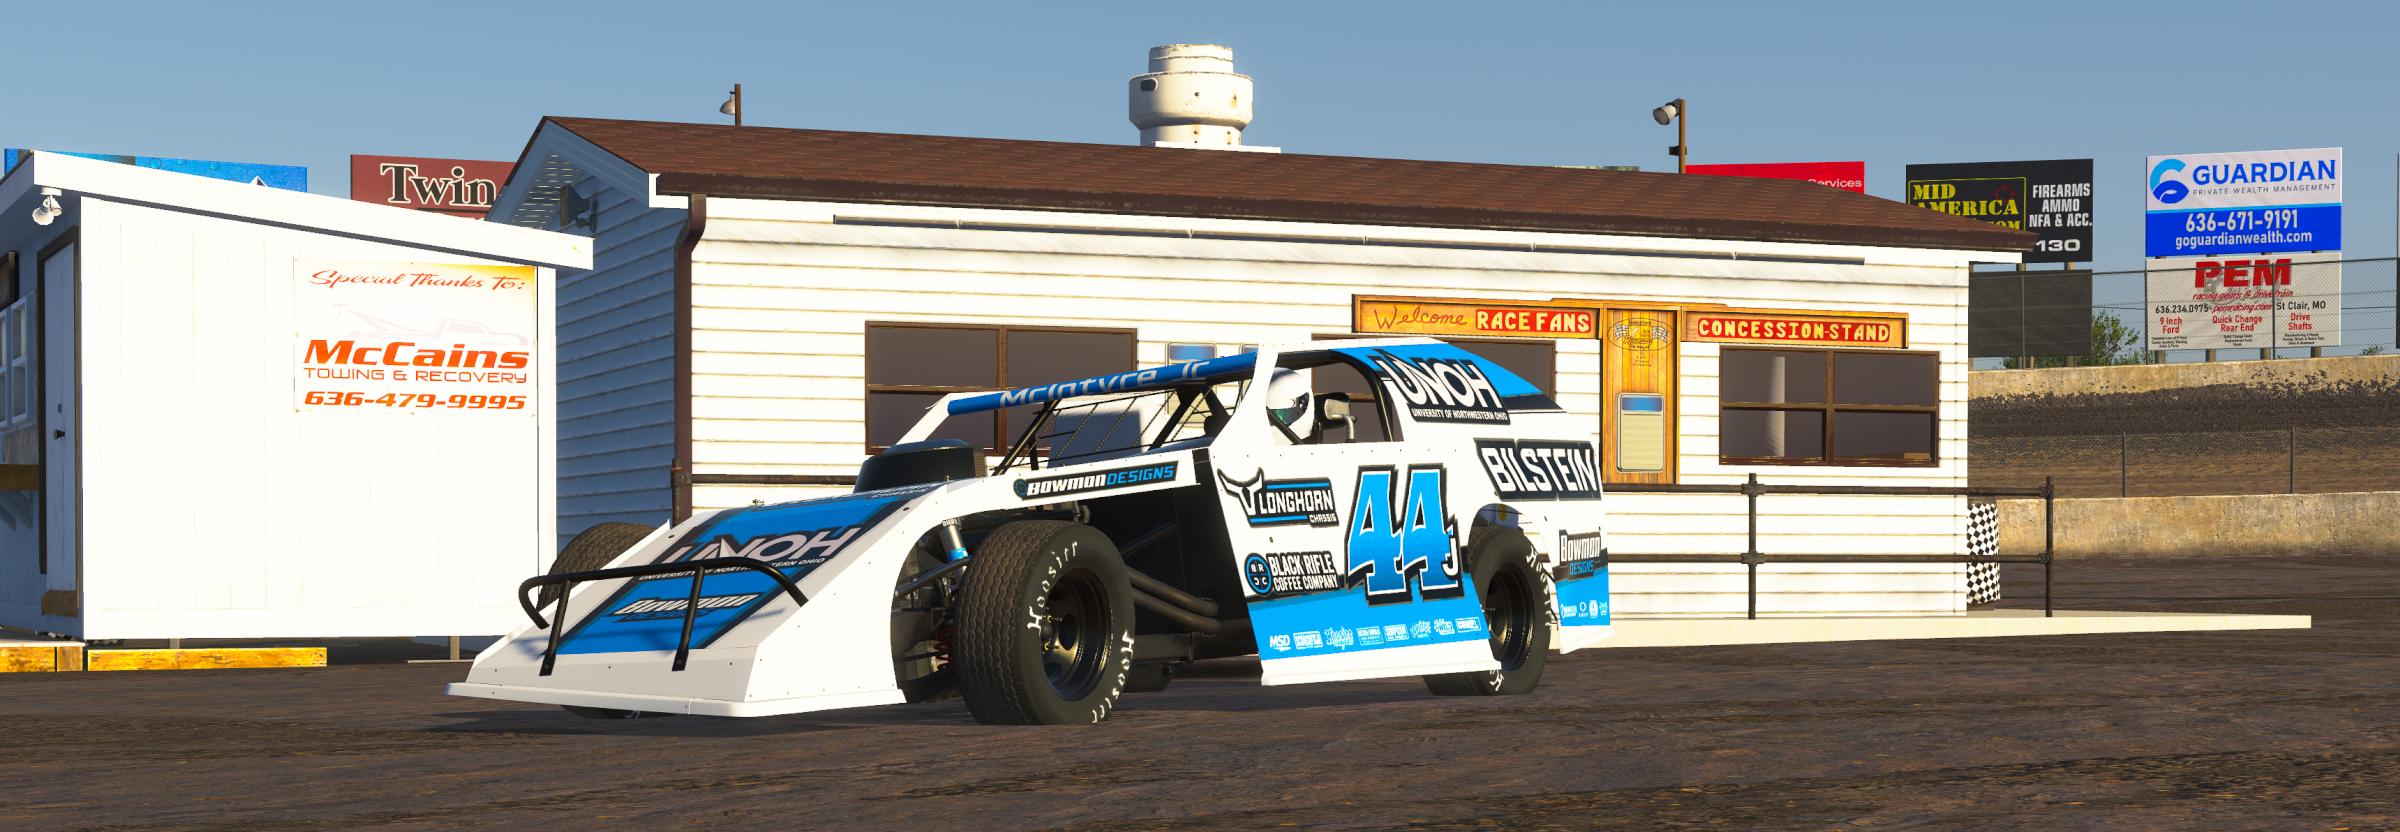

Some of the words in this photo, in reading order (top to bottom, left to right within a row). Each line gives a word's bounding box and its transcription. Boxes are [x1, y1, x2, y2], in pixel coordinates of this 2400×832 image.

[2192, 159, 2336, 186] GUARDIAN
[379, 162, 497, 208] Twin
[1912, 183, 1957, 200] MID
[2032, 183, 2091, 199] FIREARMS
[2192, 187, 2229, 196] PRIVATE
[2233, 186, 2269, 195] WEALTH
[2272, 183, 2336, 193] MANAGEMENT
[2041, 199, 2080, 213] AMMO
[2029, 214, 2051, 228] NFA
[2054, 213, 2063, 227] &
[2066, 212, 2093, 227] ACC.
[2185, 208, 2299, 233] 636-671-9191
[2035, 238, 2081, 252] 130
[2175, 230, 2313, 250] goguardianwealth.com
[309, 269, 407, 289] Special
[409, 272, 483, 289] Thanks
[492, 275, 526, 291] To:
[2195, 258, 2293, 288] PEM
[2193, 292, 2219, 301] racing
[2220, 291, 2242, 301] gears
[2244, 289, 2252, 298] &
[2155, 303, 2209, 314] 636.234.0975
[2211, 303, 2273, 314] pemracing.com
[2276, 302, 2286, 311] St
[2287, 301, 2310, 311] Clair,
[2312, 301, 2326, 310] MO
[1373, 305, 1468, 330] Welcome
[1476, 311, 1531, 331] RACE
[1535, 312, 1591, 333] FANS
[2159, 317, 2165, 325] 9
[2165, 316, 2183, 325] Inch
[2212, 315, 2233, 325] Quick
[2233, 314, 2263, 325] Change
[2290, 313, 2311, 321] Drive
[2162, 325, 2180, 334] Ford
[2220, 323, 2238, 333] Rear
[2239, 323, 2255, 332] End
[2288, 321, 2313, 331] Shafts
[303, 339, 530, 369] McCains
[303, 367, 385, 381] TOWING
[393, 370, 408, 381] &
[415, 370, 528, 384] RECOVERY
[1375, 358, 1503, 409] UNOH
[304, 390, 528, 410] 636-479-9995
[1411, 408, 1445, 419] UNIVERSITY
[1445, 410, 1453, 419] OF
[1452, 409, 1495, 420] NORTHWESTERN
[1494, 411, 1508, 421] OHIO
[1480, 447, 1599, 493] BILSTEIN
[1258, 488, 1334, 515] LONGHORN
[1308, 512, 1337, 524] CHASSIS
[1267, 554, 1305, 577] BLACK
[1302, 553, 1335, 575] RIFLE
[1568, 559, 1595, 577] DESIGNS
[1272, 575, 1303, 592] COFFEE
[1301, 573, 1339, 590] COMPANY
[1269, 634, 1292, 649] MSD
